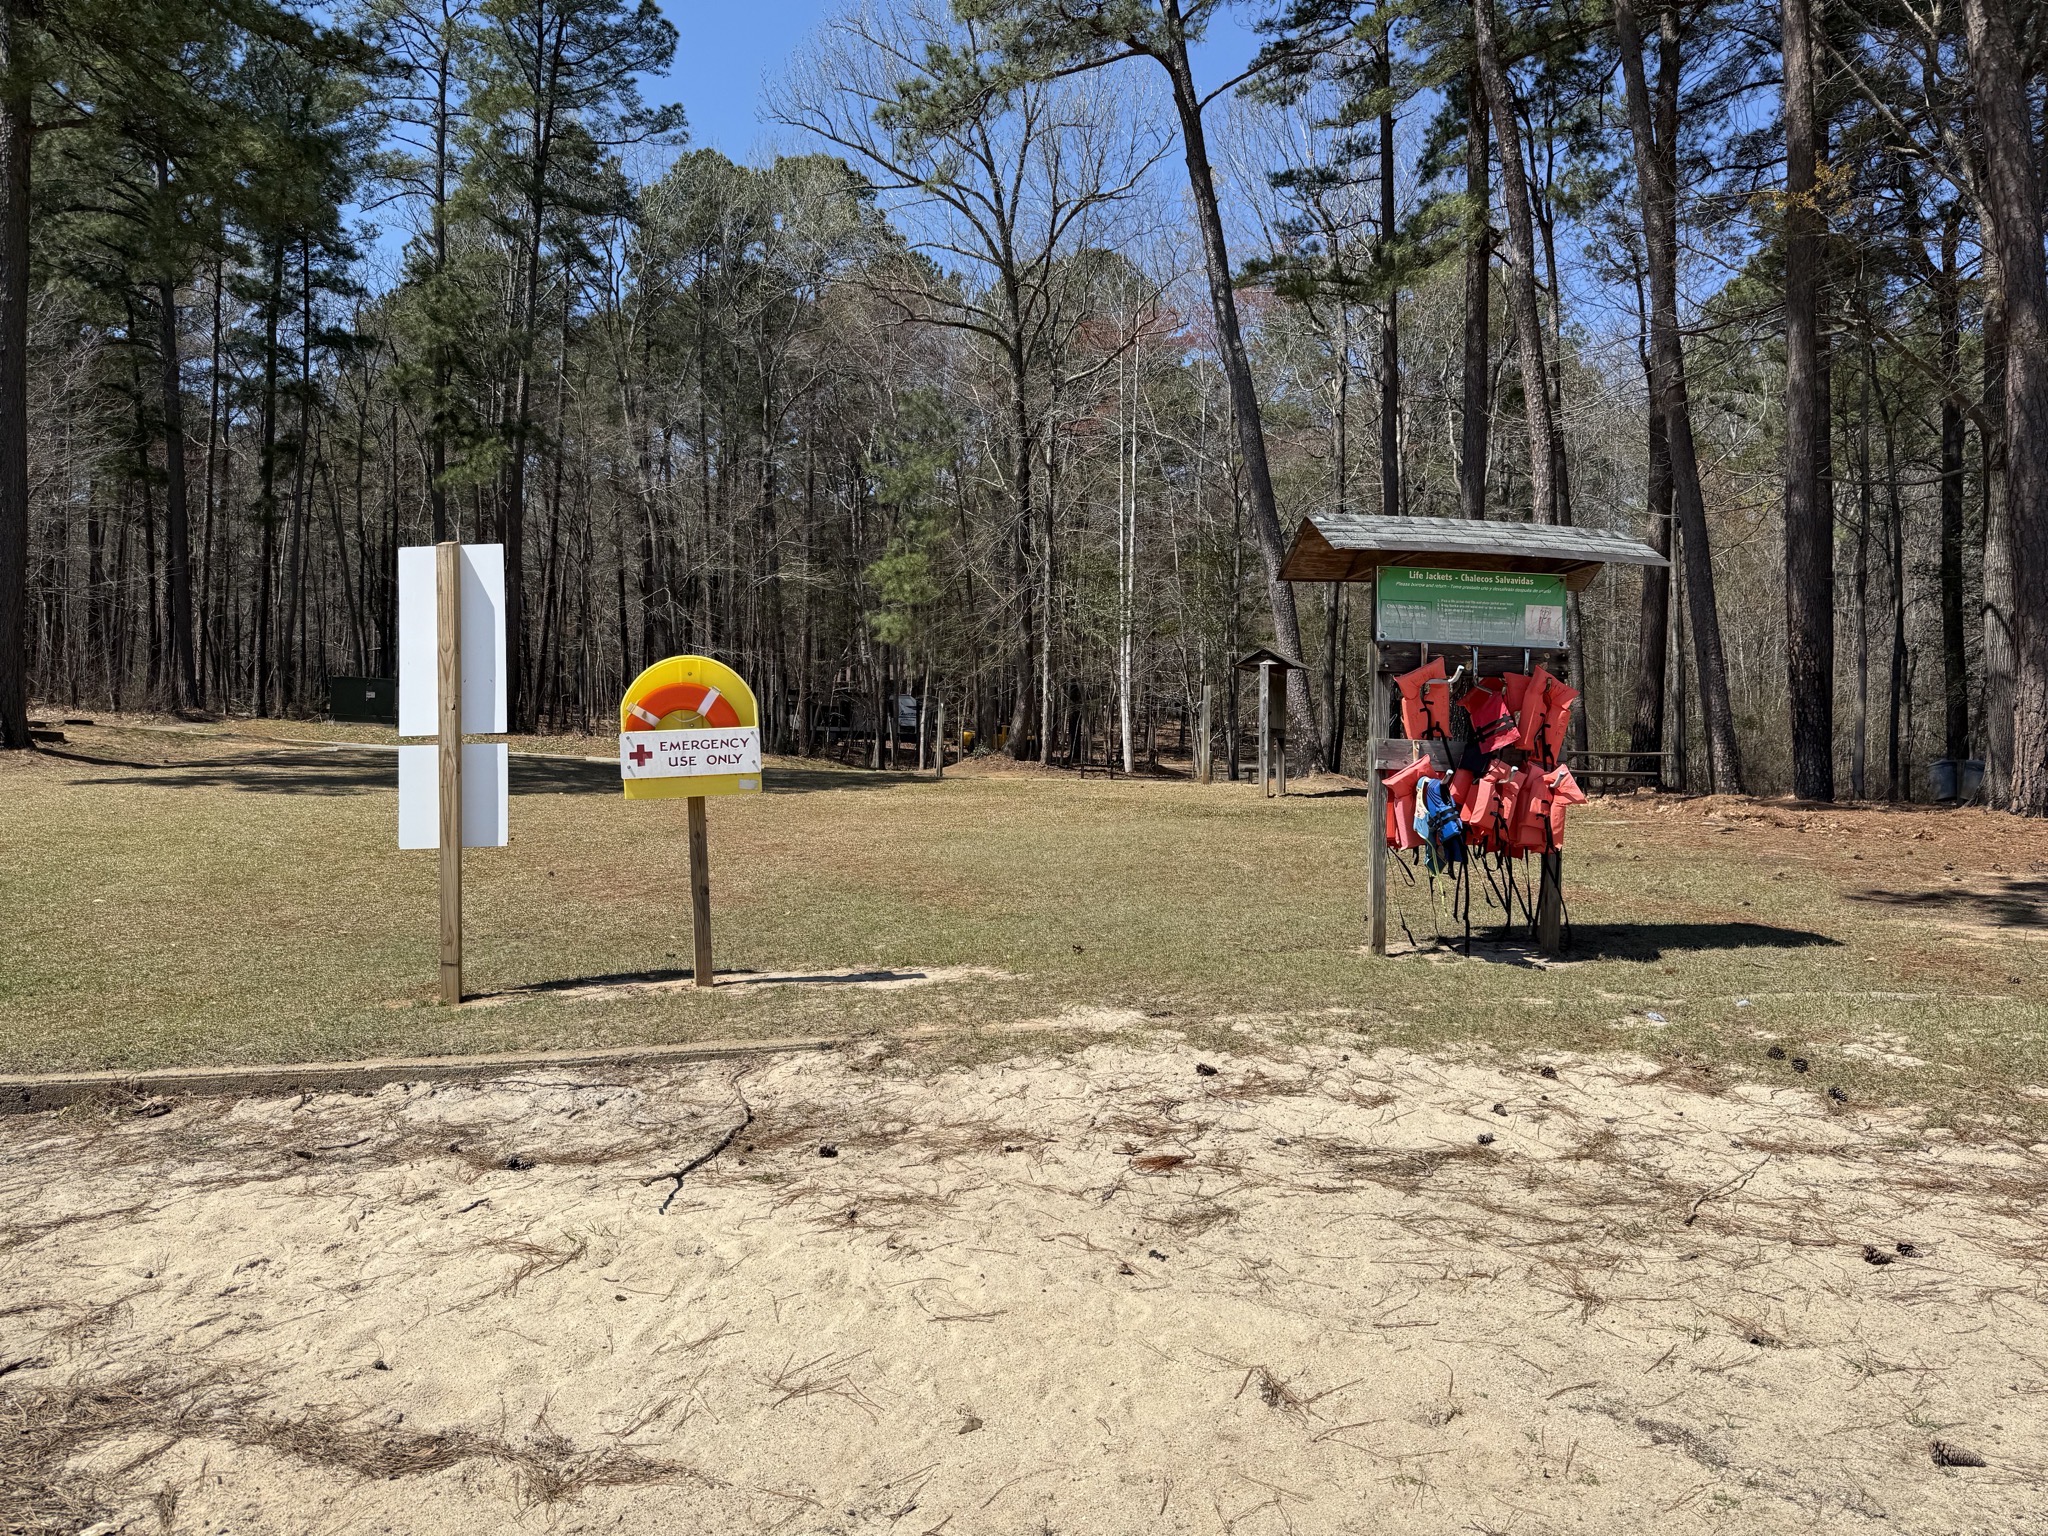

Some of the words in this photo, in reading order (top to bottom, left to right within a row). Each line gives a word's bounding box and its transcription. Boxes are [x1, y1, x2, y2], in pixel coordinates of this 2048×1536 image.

[1409, 571, 1423, 580] Life
[1426, 572, 1452, 581] Jackets
[1461, 574, 1492, 583] Chalecos
[1495, 576, 1534, 585] Salvavidas
[660, 737, 750, 752] EMERGENCY
[668, 756, 697, 767] USE
[706, 754, 744, 766] ONLY
